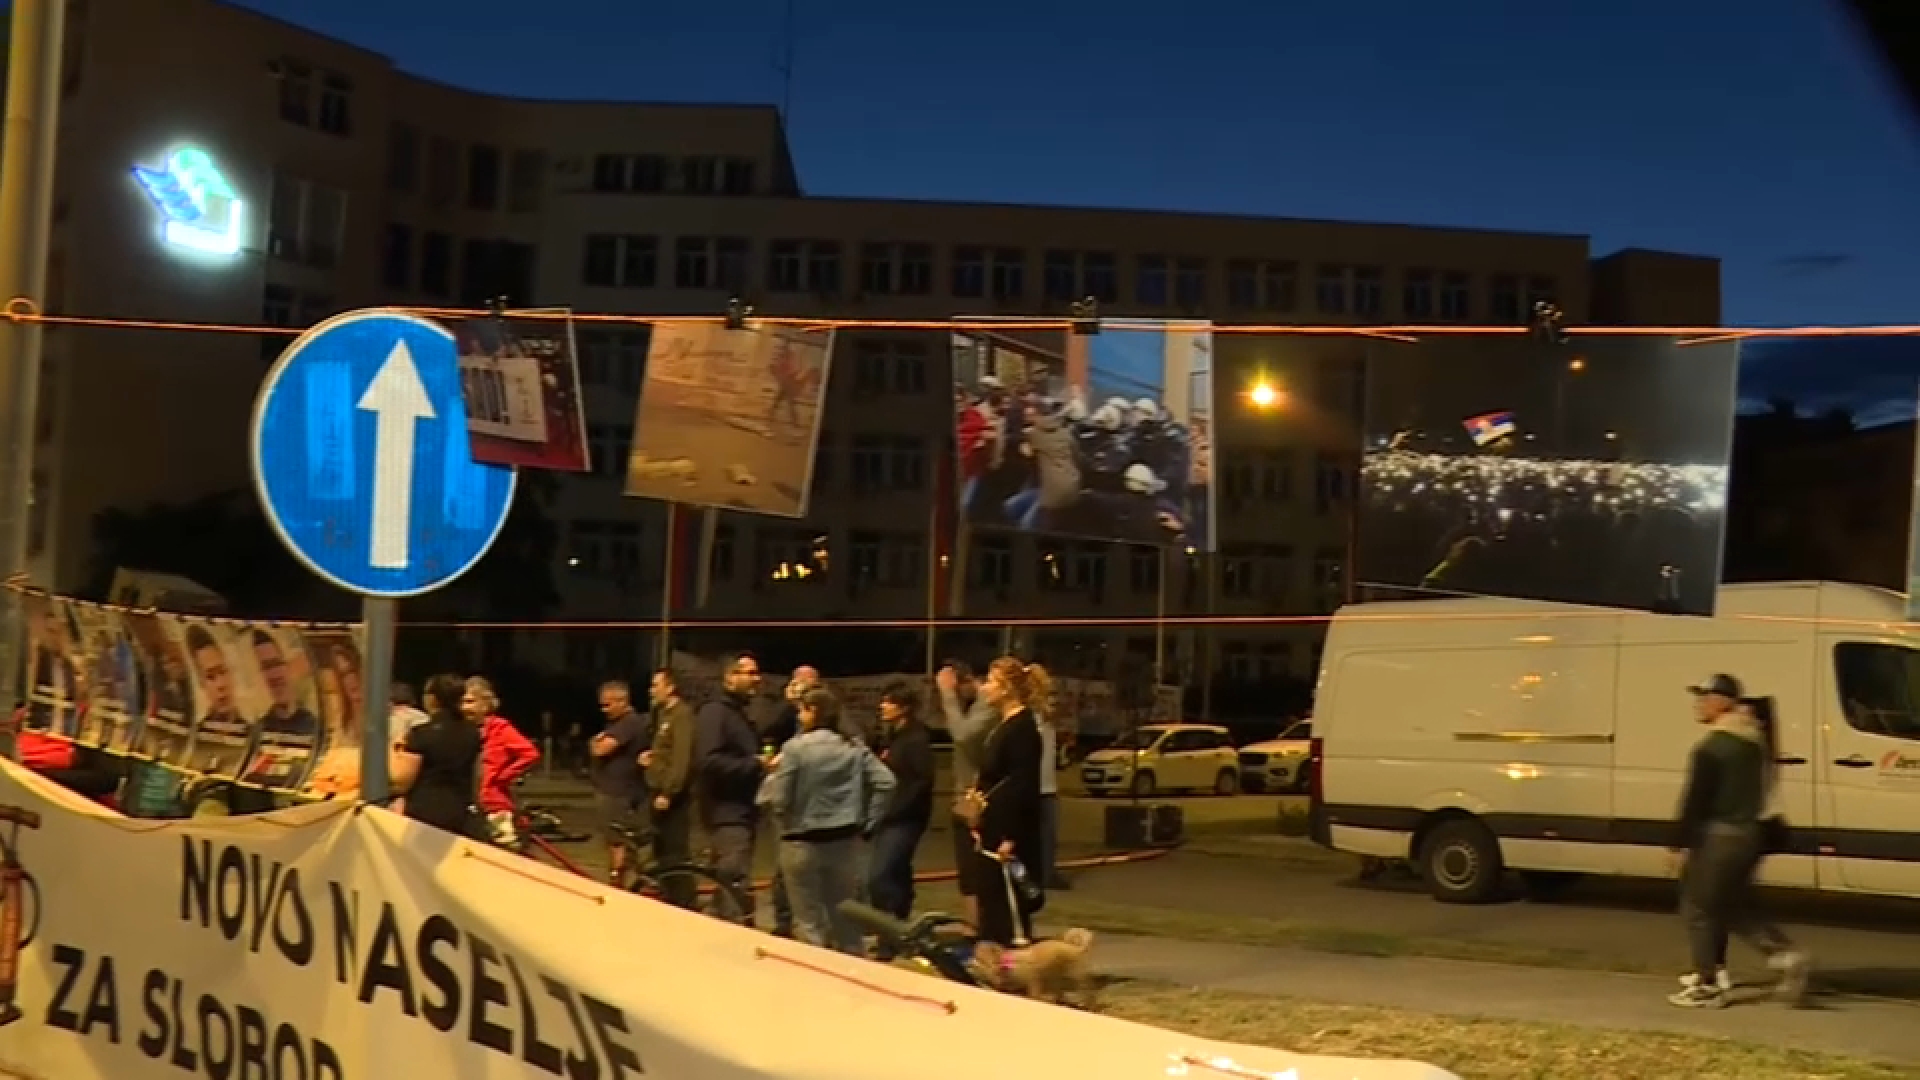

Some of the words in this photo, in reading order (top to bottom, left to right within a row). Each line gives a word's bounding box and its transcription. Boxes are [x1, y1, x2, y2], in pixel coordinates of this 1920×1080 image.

[44, 943, 120, 1043] ZA
[181, 834, 314, 966] NOVO
[328, 880, 644, 1080] NASELJE
